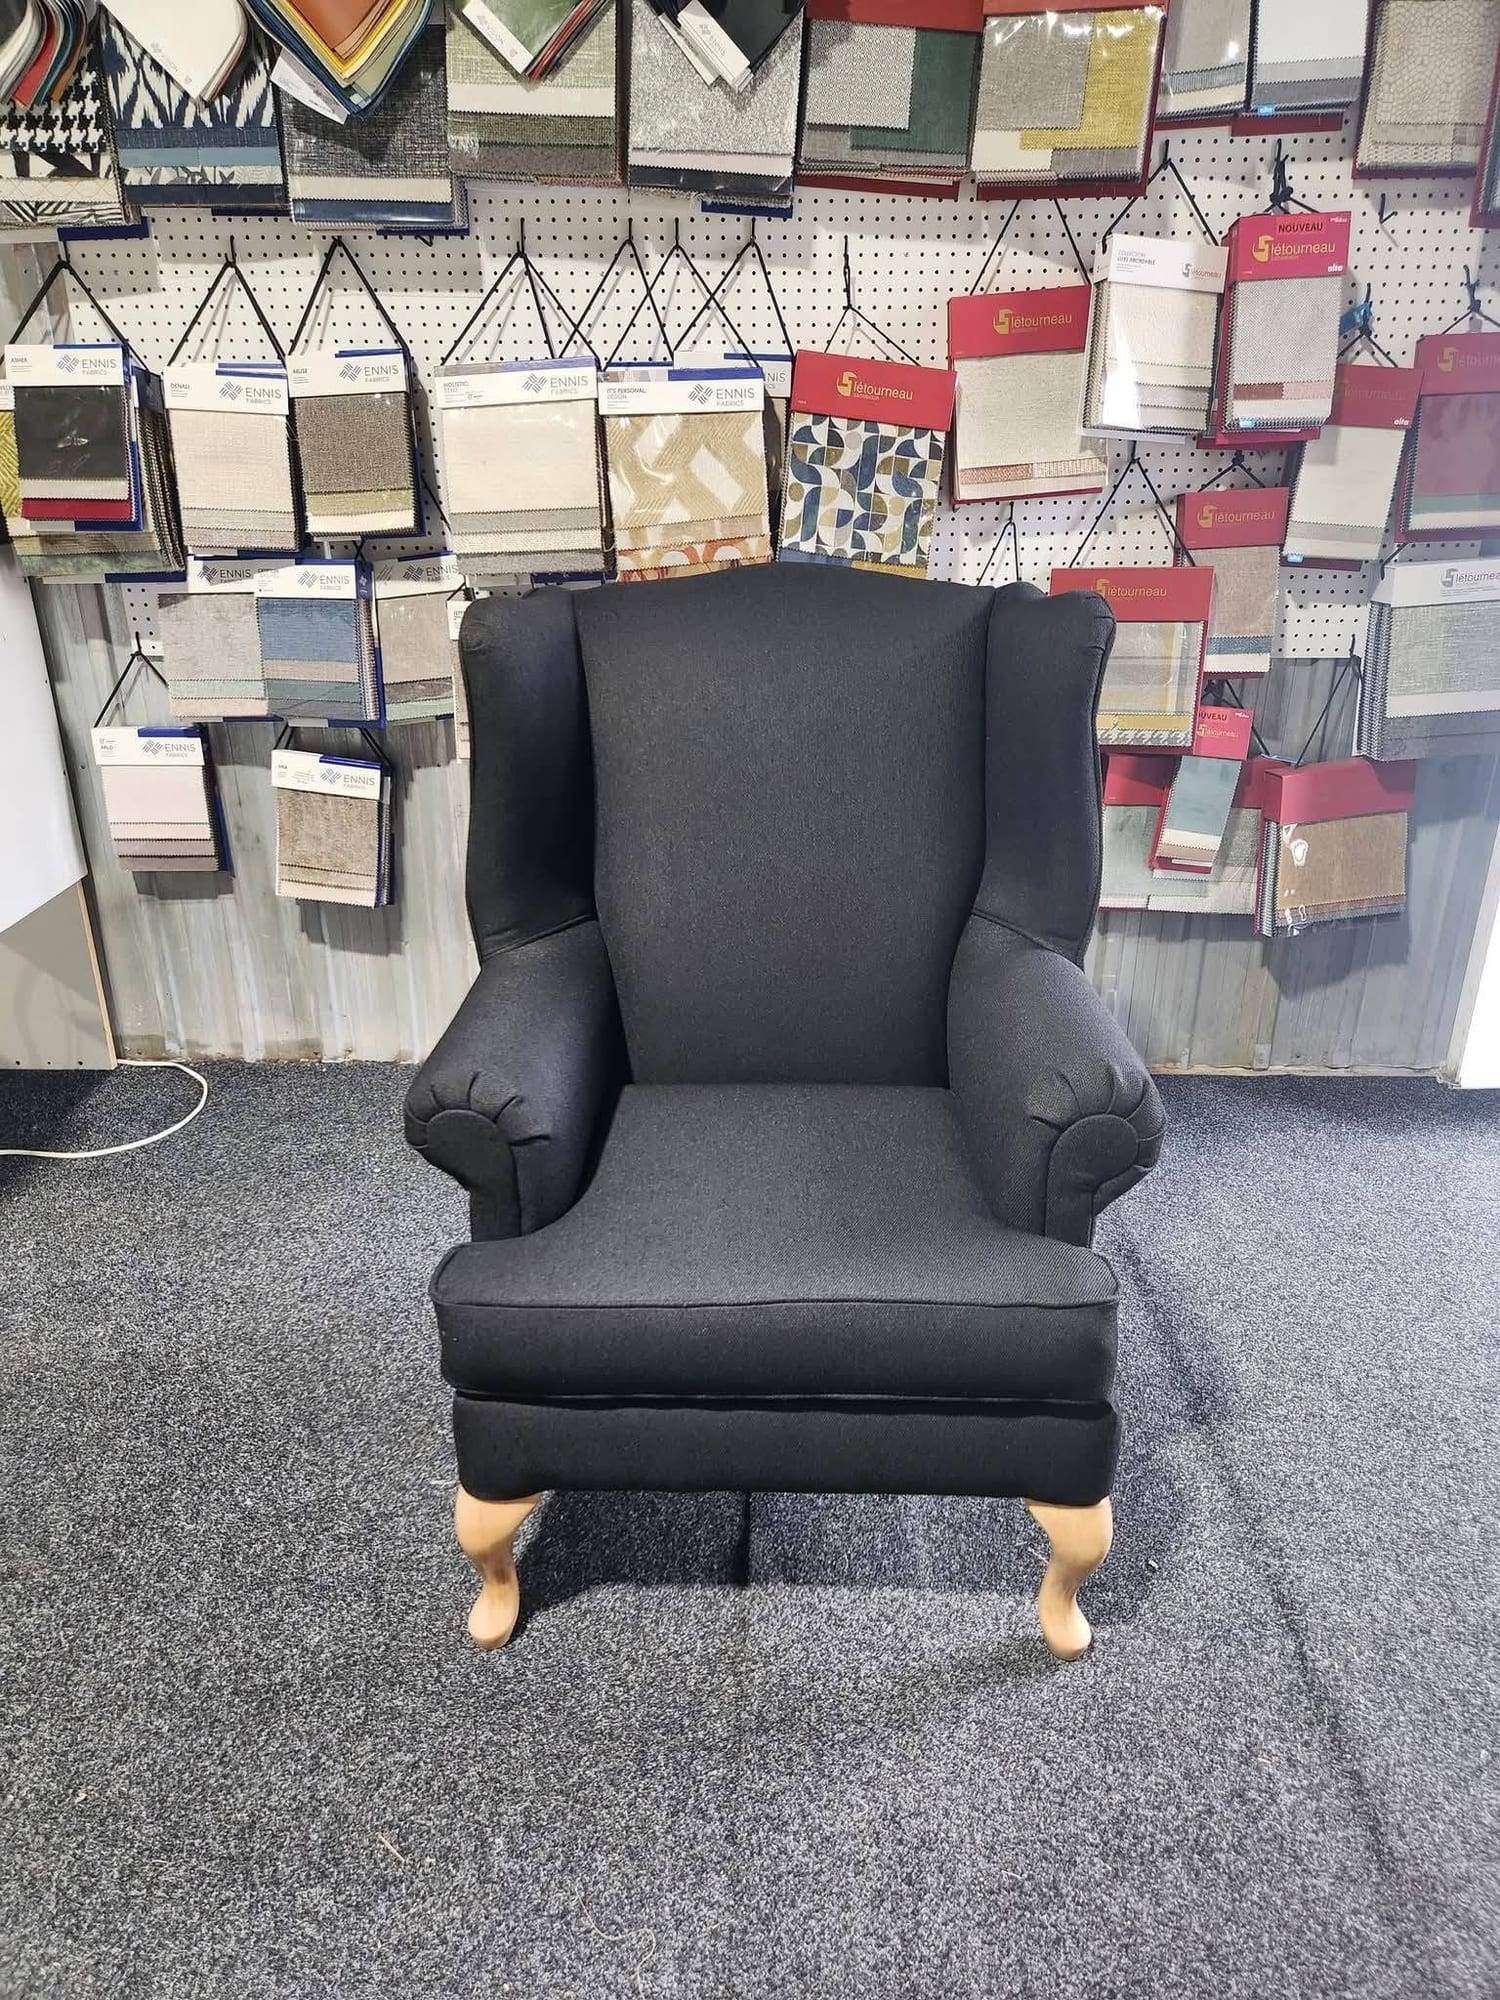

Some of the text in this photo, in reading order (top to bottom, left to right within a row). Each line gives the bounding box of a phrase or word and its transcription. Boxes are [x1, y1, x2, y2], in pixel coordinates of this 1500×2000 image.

[1278, 222, 1323, 233] NOUVEAU
[1271, 242, 1336, 256] létourneau
[1011, 313, 1073, 329] létourneau
[82, 359, 117, 369] ENNIS
[364, 364, 399, 377] ENNIS
[550, 375, 589, 388] ENNIS
[245, 387, 282, 399] ENNIS
[716, 388, 755, 400] ENNIS
[853, 380, 914, 401] létourneau
[220, 568, 252, 579] ENNIS
[426, 564, 459, 577] ENNIS
[319, 574, 350, 586] ENNIS
[1199, 711, 1228, 721] UVEAU
[164, 743, 197, 753] ENNIS
[343, 774, 376, 786] ENNIS
